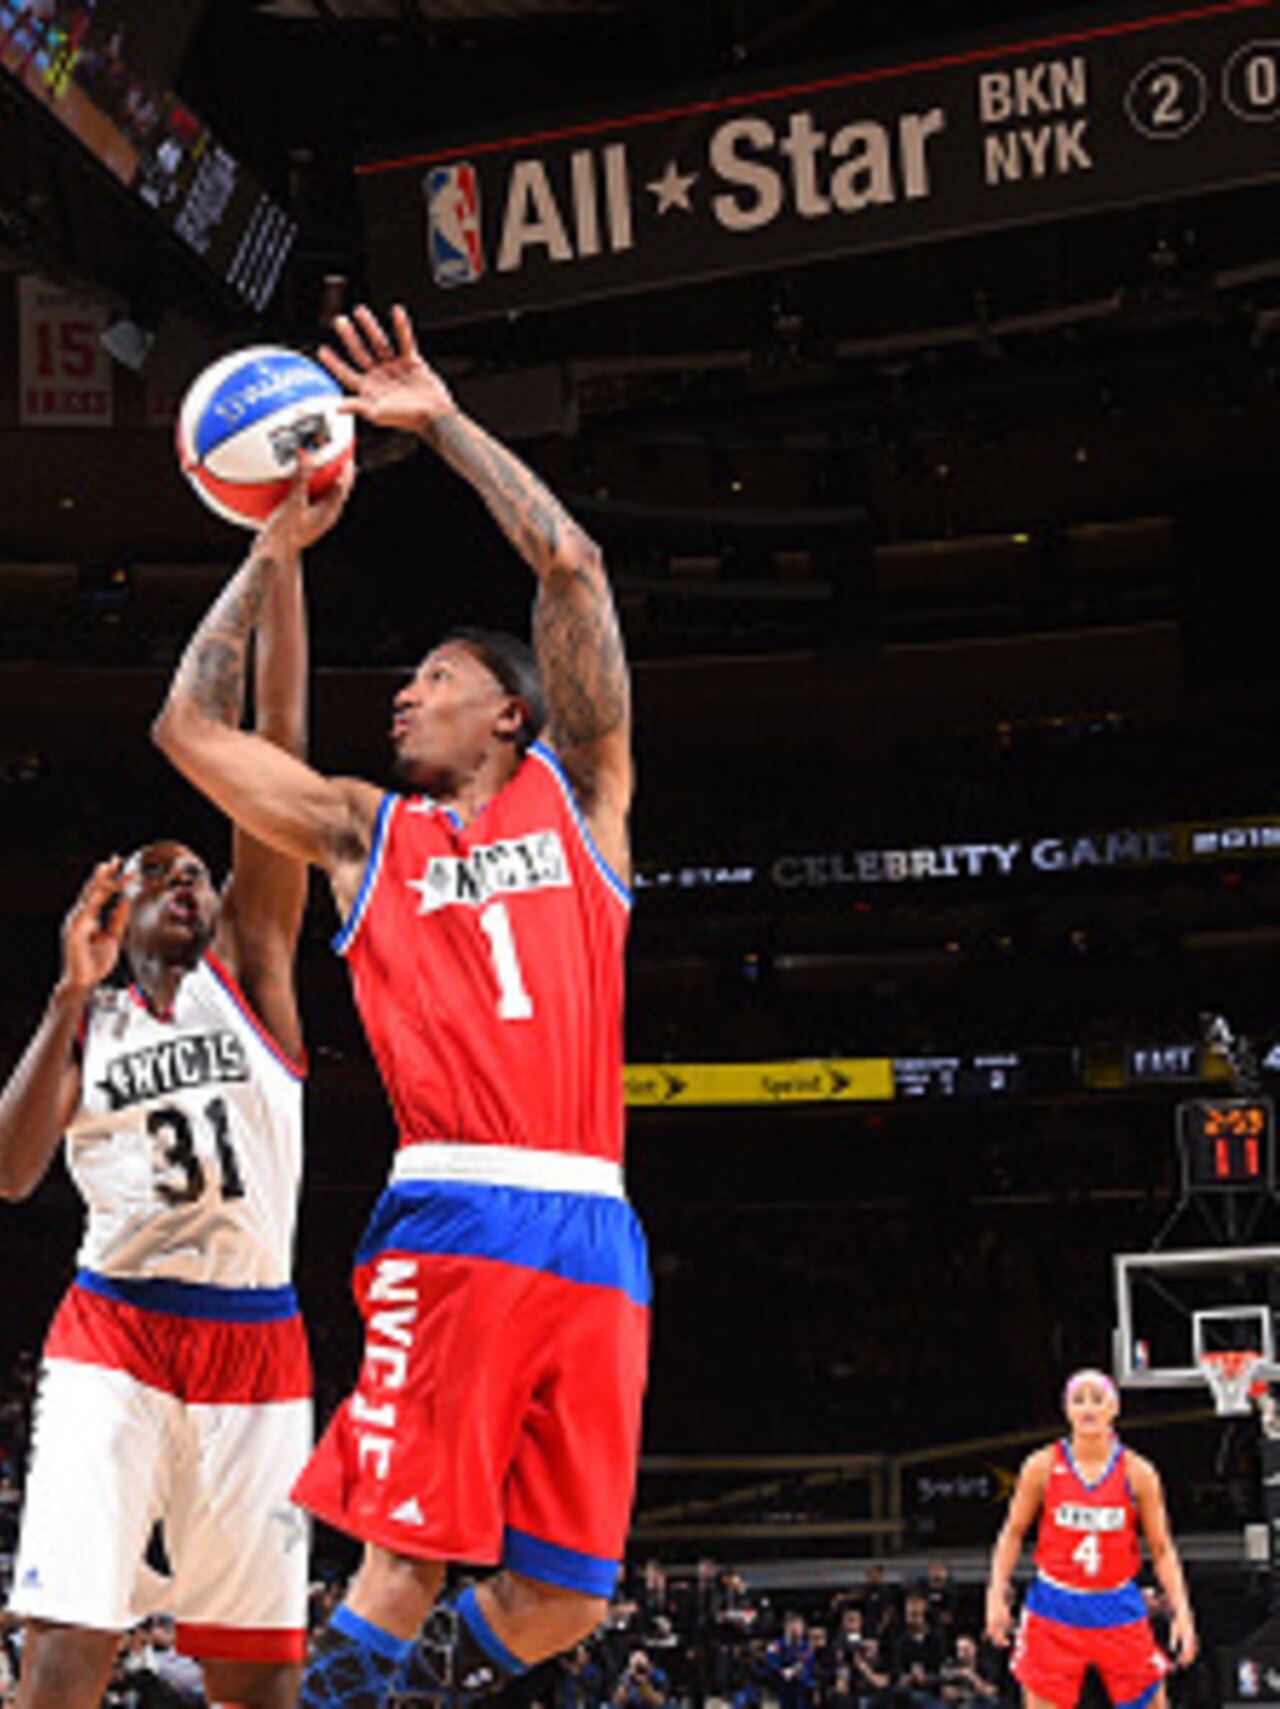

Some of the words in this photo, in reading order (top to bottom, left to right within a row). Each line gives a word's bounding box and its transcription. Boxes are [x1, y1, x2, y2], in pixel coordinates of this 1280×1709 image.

[979, 56, 1086, 123] BKN
[984, 119, 1092, 186] NYK
[496, 144, 633, 272] All
[709, 108, 945, 232] Star
[37, 321, 95, 378] 15
[772, 844, 1020, 887] CELEBRITY
[1030, 832, 1171, 870] GAME
[481, 902, 532, 1019] 1
[146, 1098, 245, 1206] 31
[1072, 1533, 1102, 1577] 4
